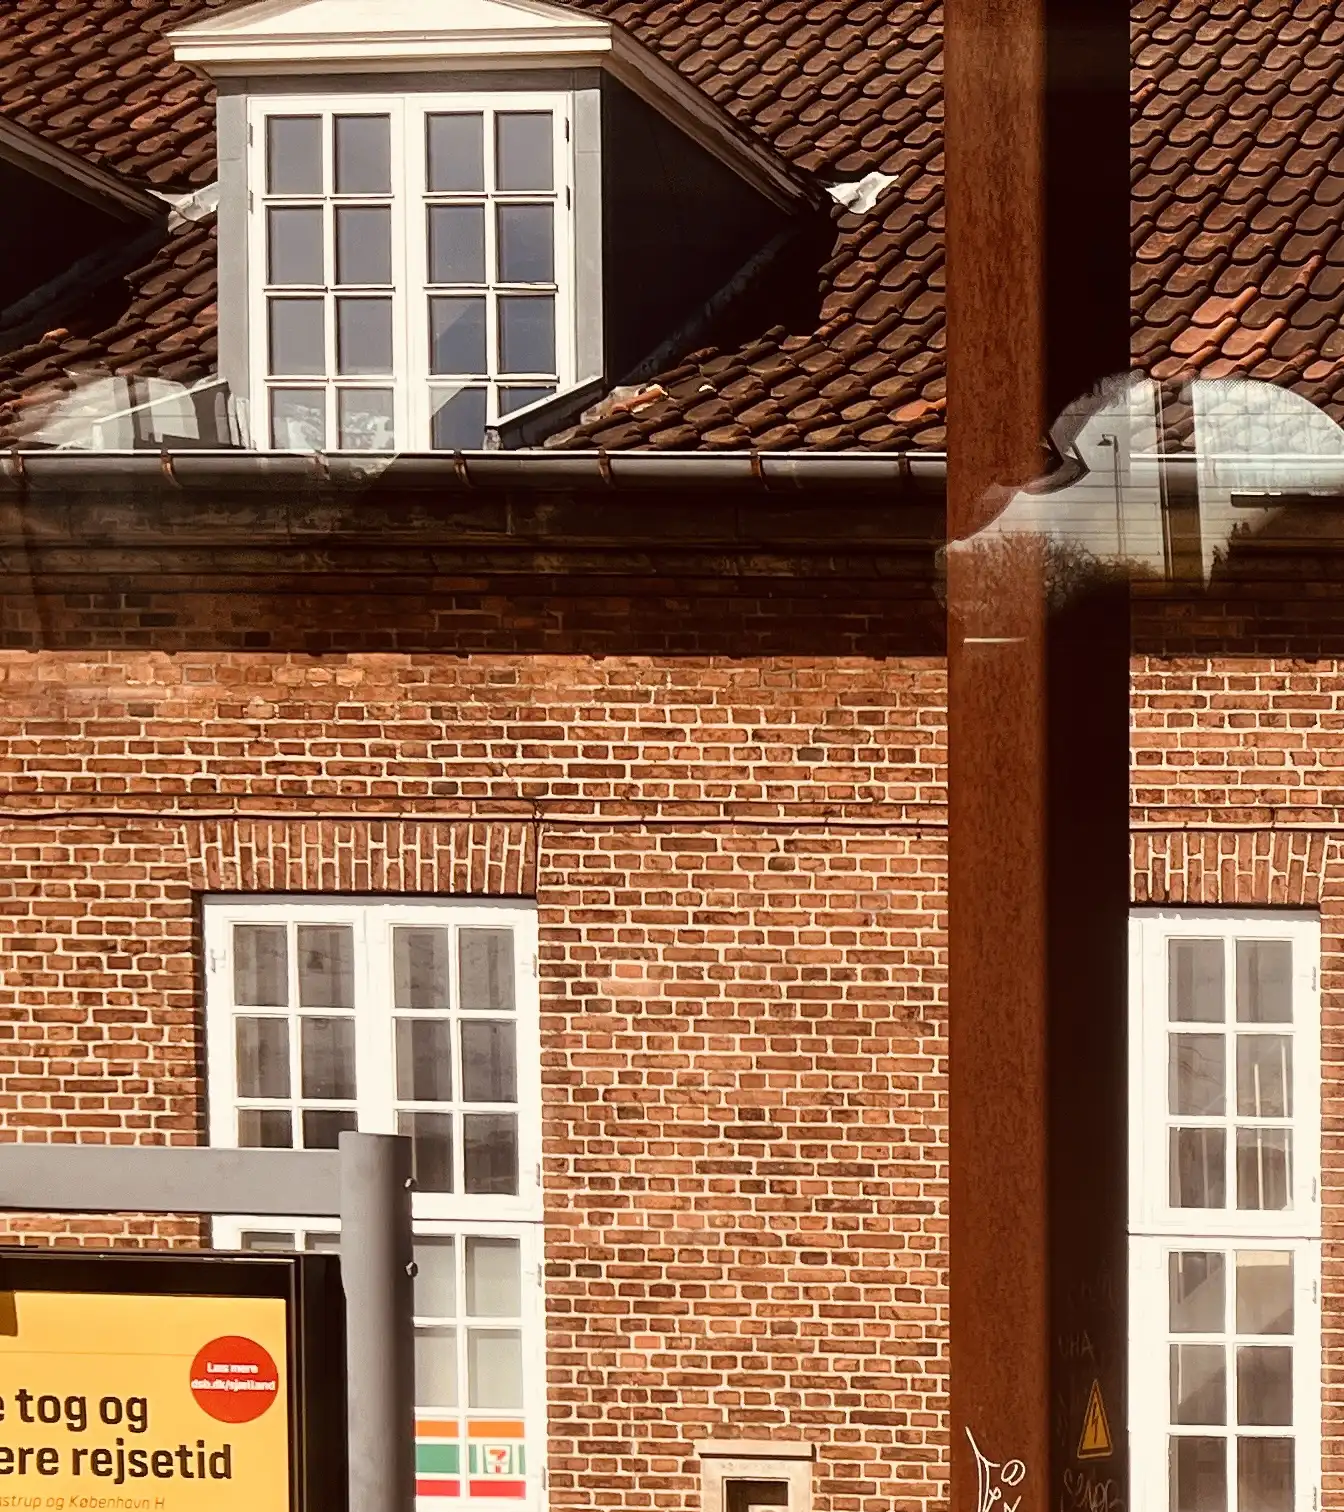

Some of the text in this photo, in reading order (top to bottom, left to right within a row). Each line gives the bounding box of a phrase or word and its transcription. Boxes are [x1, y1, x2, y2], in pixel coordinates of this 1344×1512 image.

[15, 1388, 87, 1432] tog
[99, 1396, 148, 1434] og
[71, 1438, 233, 1485] rejsetid
[0, 1494, 166, 1511] strup og København H
